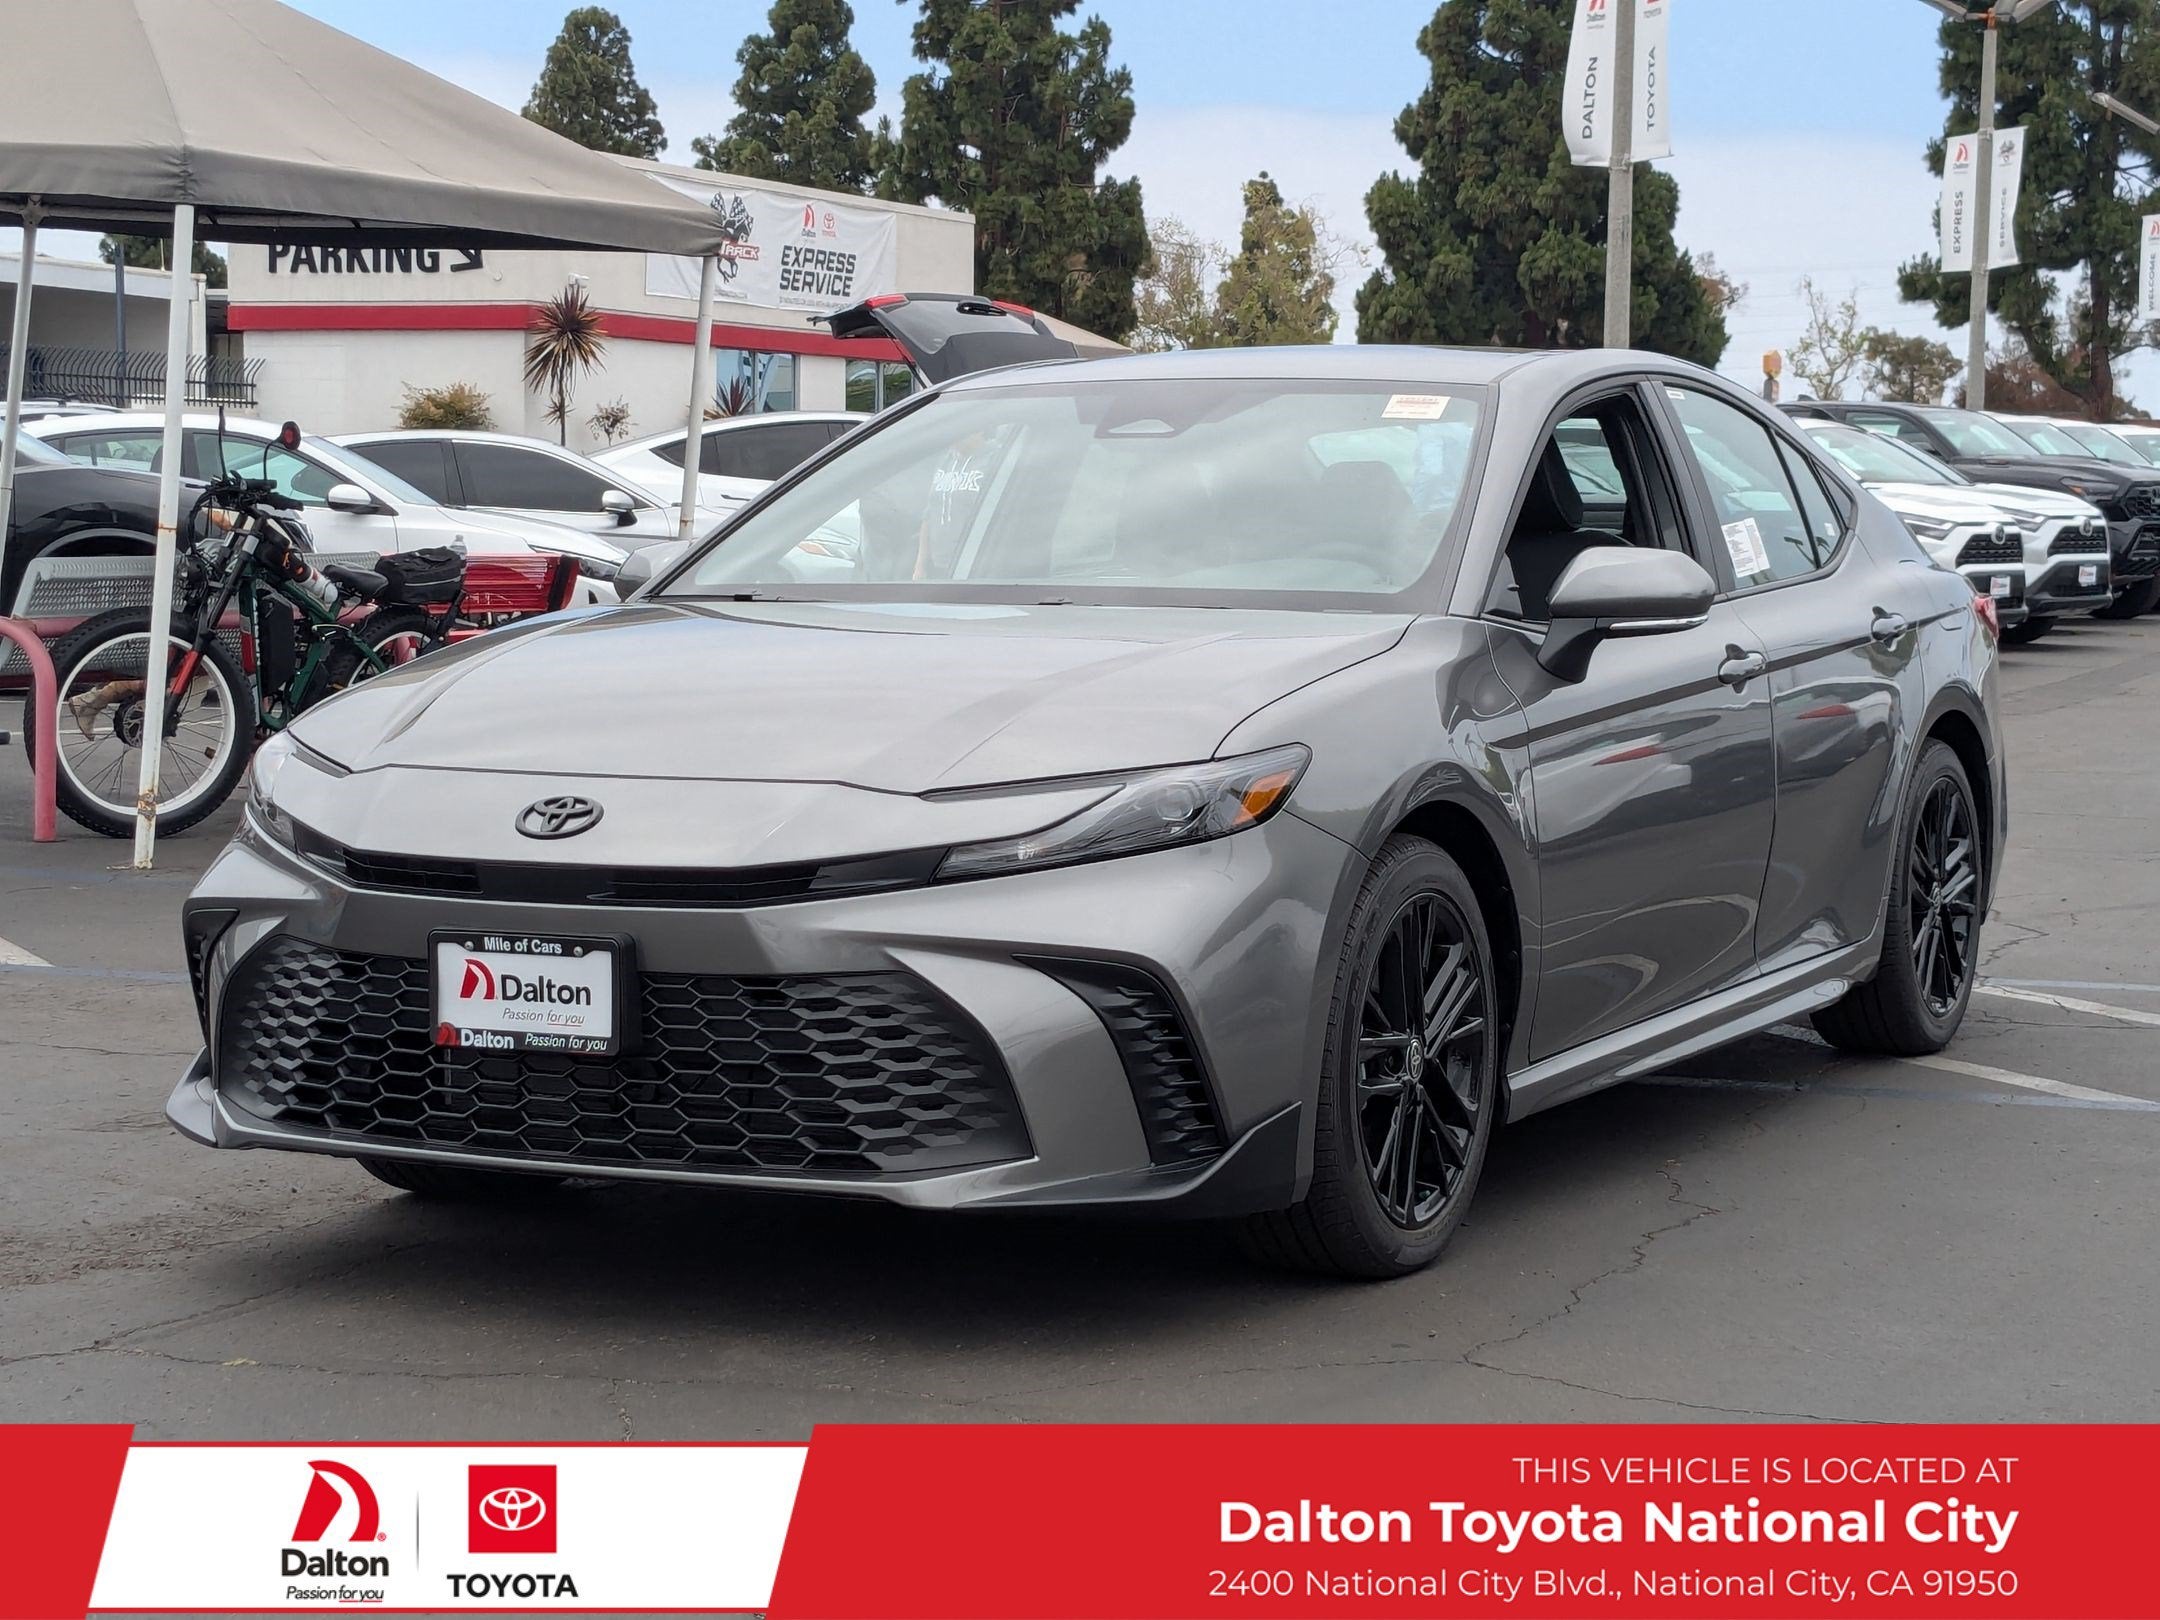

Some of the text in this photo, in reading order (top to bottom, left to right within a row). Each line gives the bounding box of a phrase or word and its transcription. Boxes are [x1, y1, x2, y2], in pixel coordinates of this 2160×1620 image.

[1582, 56, 1598, 139] DALTON
[1646, 46, 1656, 132] TOYOTA
[1953, 191, 1963, 254] EXPRESS
[268, 244, 440, 273] PARKING
[781, 245, 856, 274] EXPRESS
[779, 268, 853, 297] SERVICE
[2148, 253, 2156, 311] WELCOME
[484, 936, 562, 954] Mile of Cars
[501, 974, 591, 1006] Dalton
[502, 1008, 585, 1024] Passion for you
[461, 1028, 608, 1051] Dalton Passion for you
